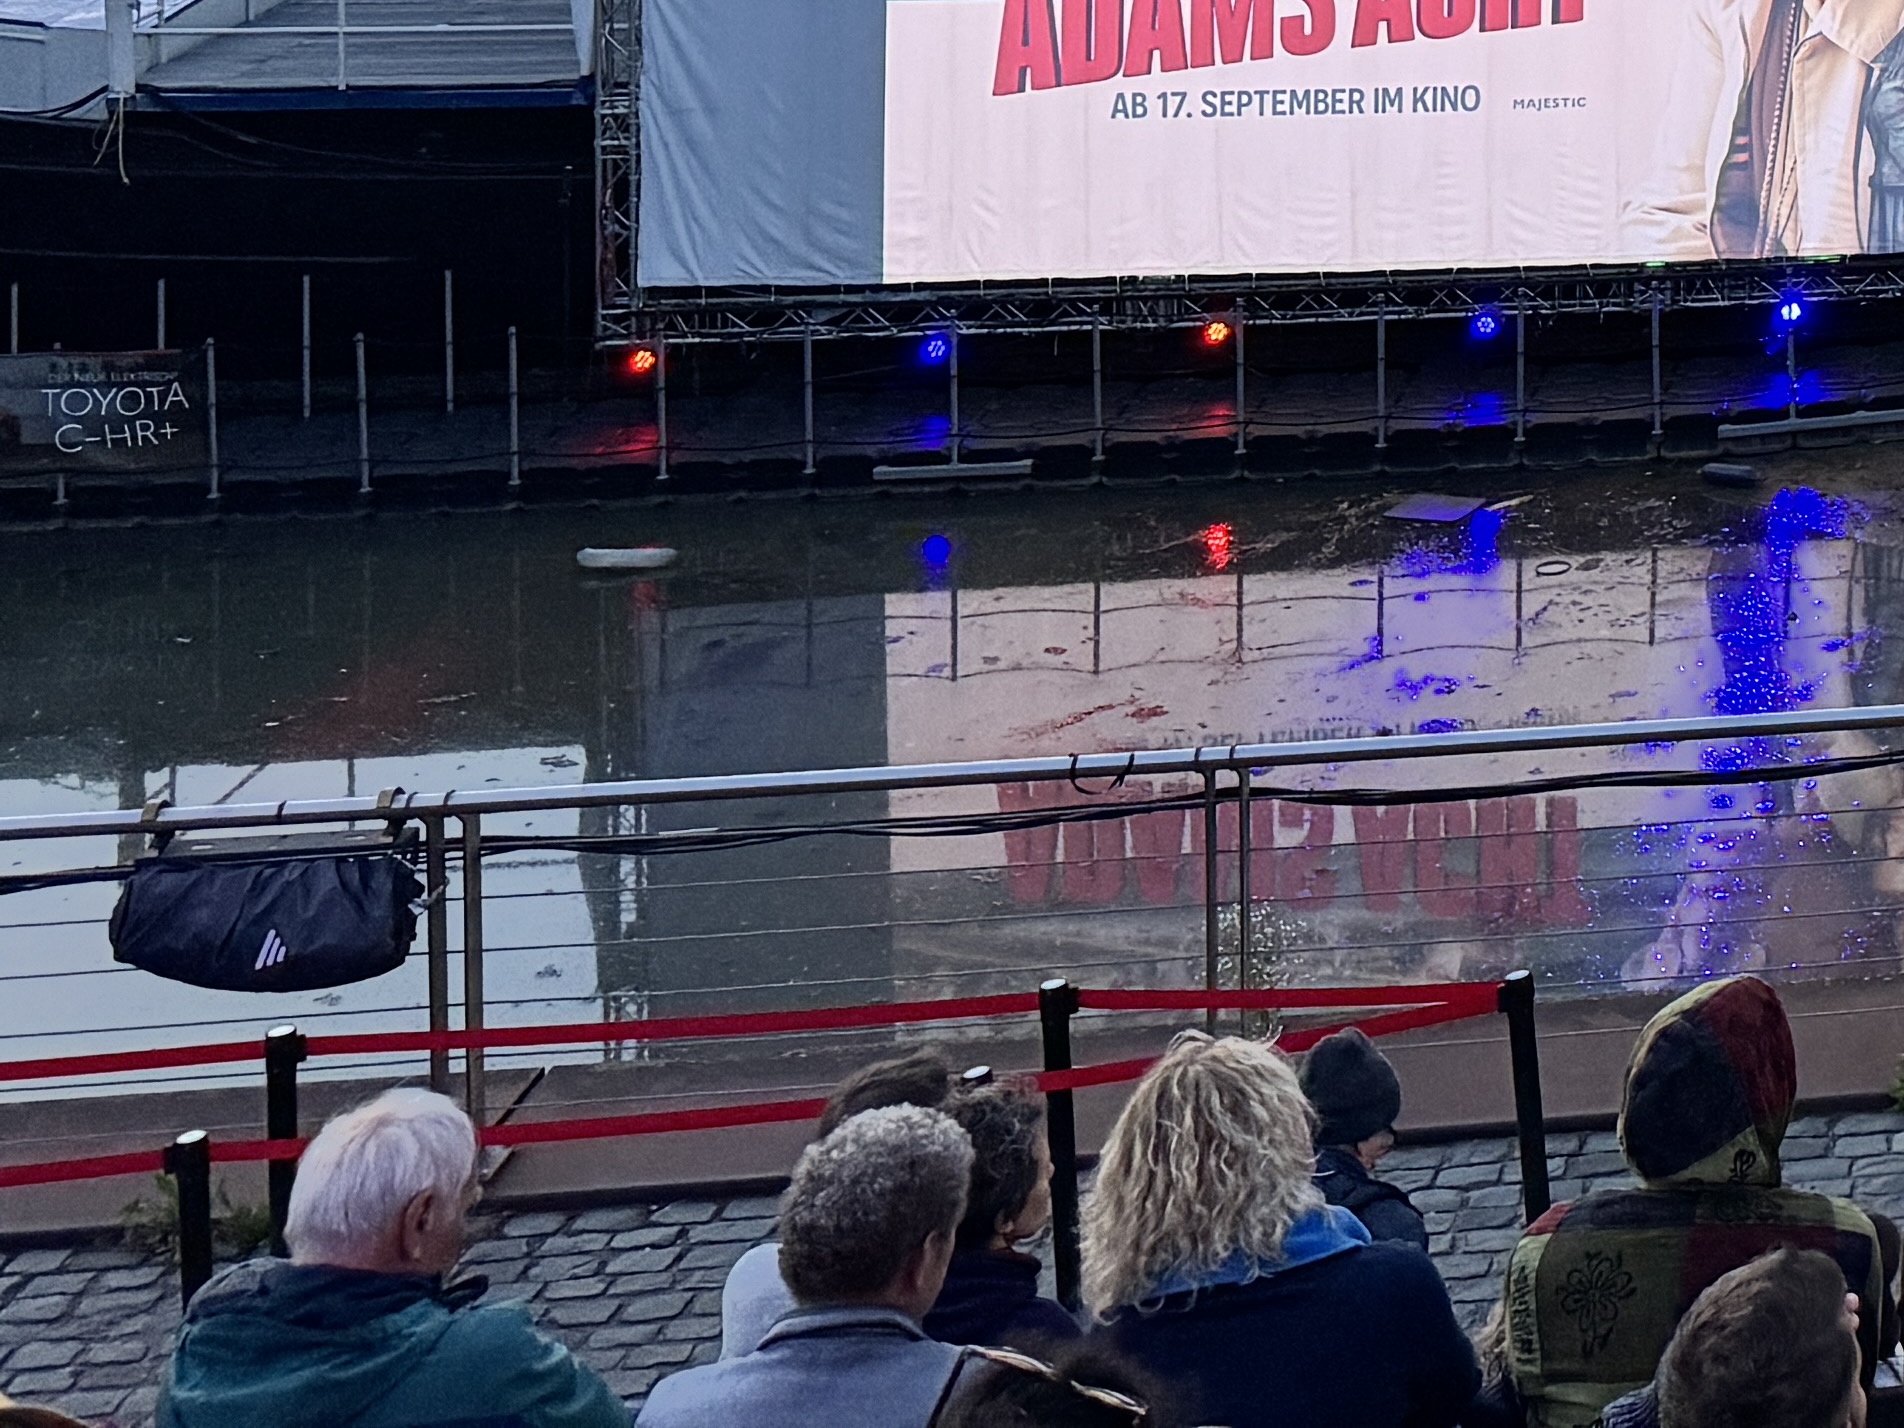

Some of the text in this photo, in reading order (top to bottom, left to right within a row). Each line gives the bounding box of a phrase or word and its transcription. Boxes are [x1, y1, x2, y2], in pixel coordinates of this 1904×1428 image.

[1111, 84, 1482, 120] AB 17. SEPTEMBER IM KINO
[1512, 96, 1588, 112] MAJESTIC
[40, 381, 190, 417] TOYOTA
[55, 419, 181, 453] C-HR+
